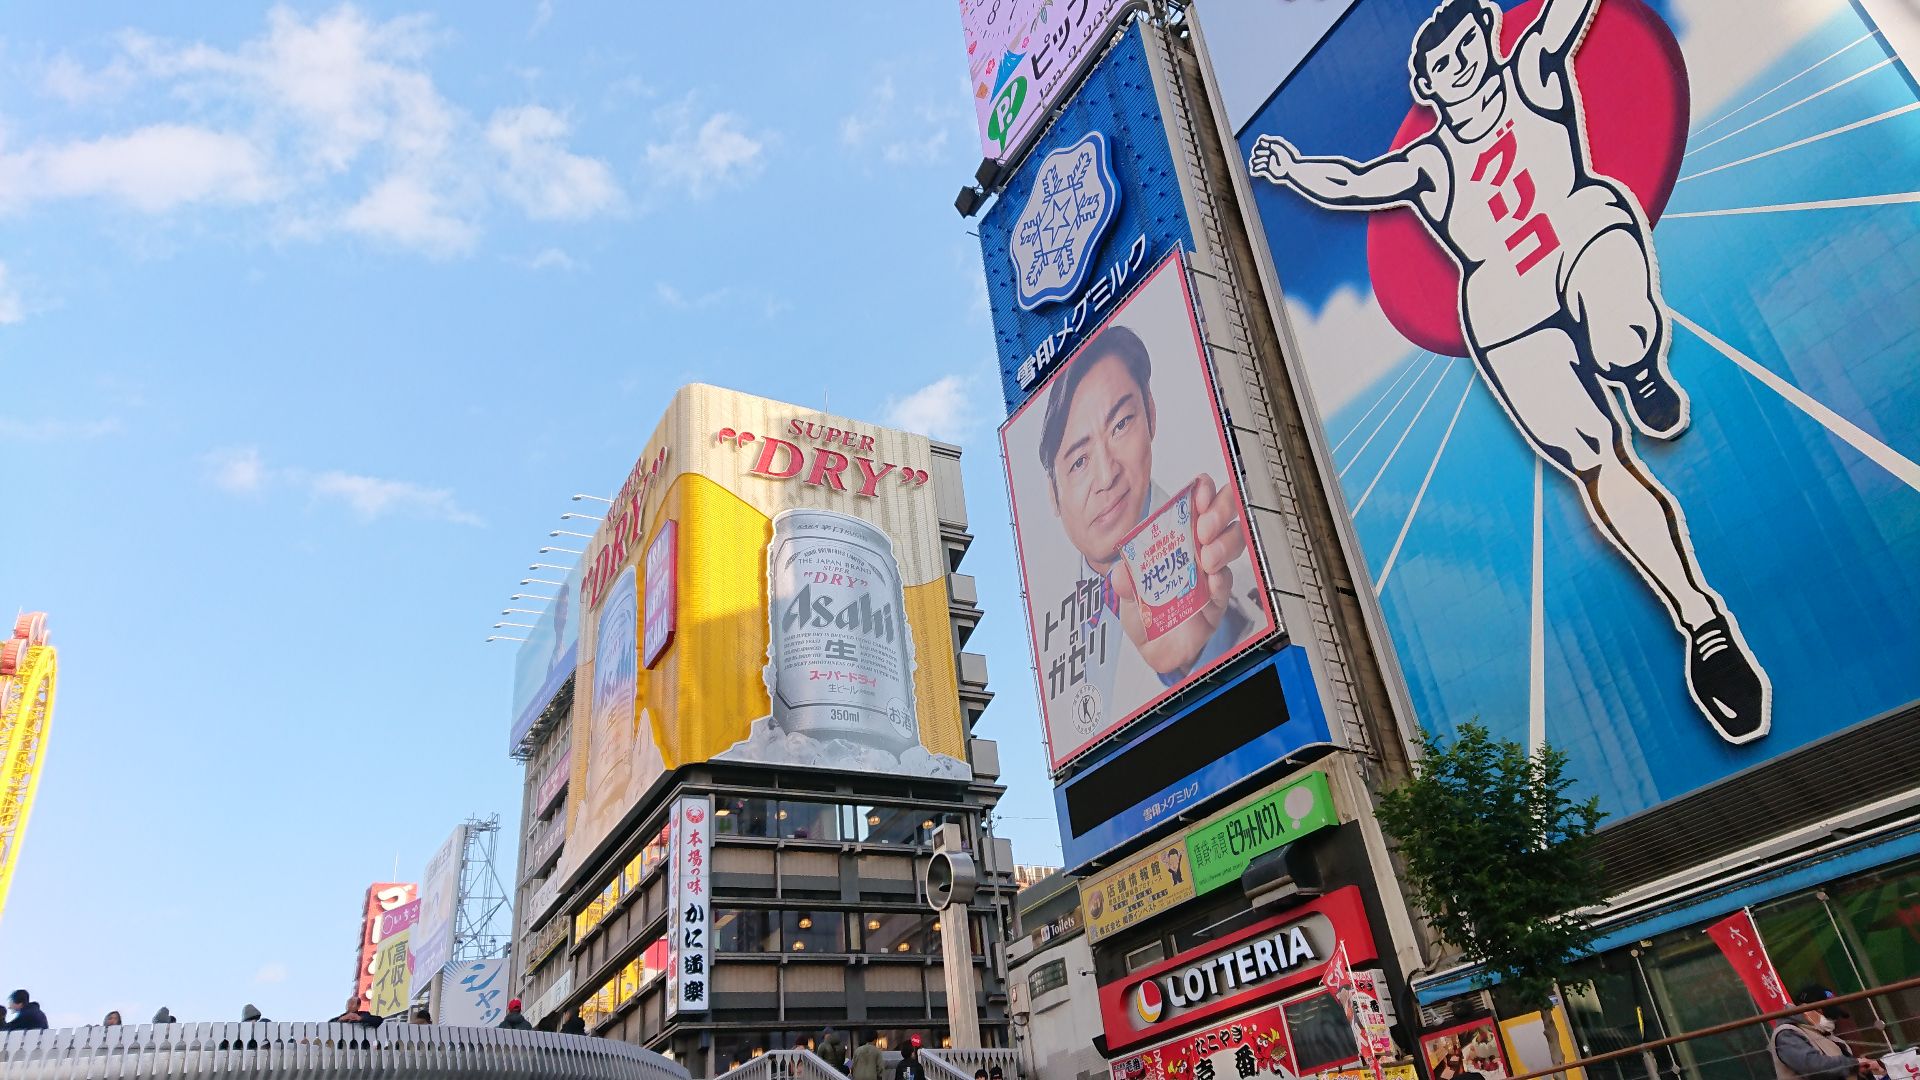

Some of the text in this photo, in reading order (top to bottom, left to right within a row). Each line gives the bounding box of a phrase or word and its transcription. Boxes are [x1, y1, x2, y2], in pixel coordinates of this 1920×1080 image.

[1470, 118, 1561, 277] グリコ
[1017, 233, 1146, 390] 雪印メグミルク
[788, 418, 876, 453] SUPER
[816, 558, 842, 567] JAPAN
[1153, 575, 1185, 601] ヨーグルト
[782, 583, 894, 645] Asahi
[1044, 577, 1101, 652] トクホ
[824, 639, 858, 662] 生
[1049, 622, 1107, 700] ガセリ
[809, 670, 877, 687] スーパードライ
[828, 684, 859, 695] 生ビール
[830, 709, 860, 723] 350ml
[889, 706, 912, 732] お酒
[1143, 782, 1199, 822] 雪印メグミルク
[1226, 801, 1285, 857] ピタットハウス
[686, 829, 703, 896] 本場の味
[1106, 860, 1161, 899] 店舗情報館
[1050, 917, 1075, 936] Toilets
[684, 903, 704, 1001] かに道楽
[1167, 925, 1316, 1008] LOTTERIA
[375, 946, 393, 1017] バイト
[387, 940, 409, 1011] 高収入
[1195, 1023, 1244, 1055] たこやき
